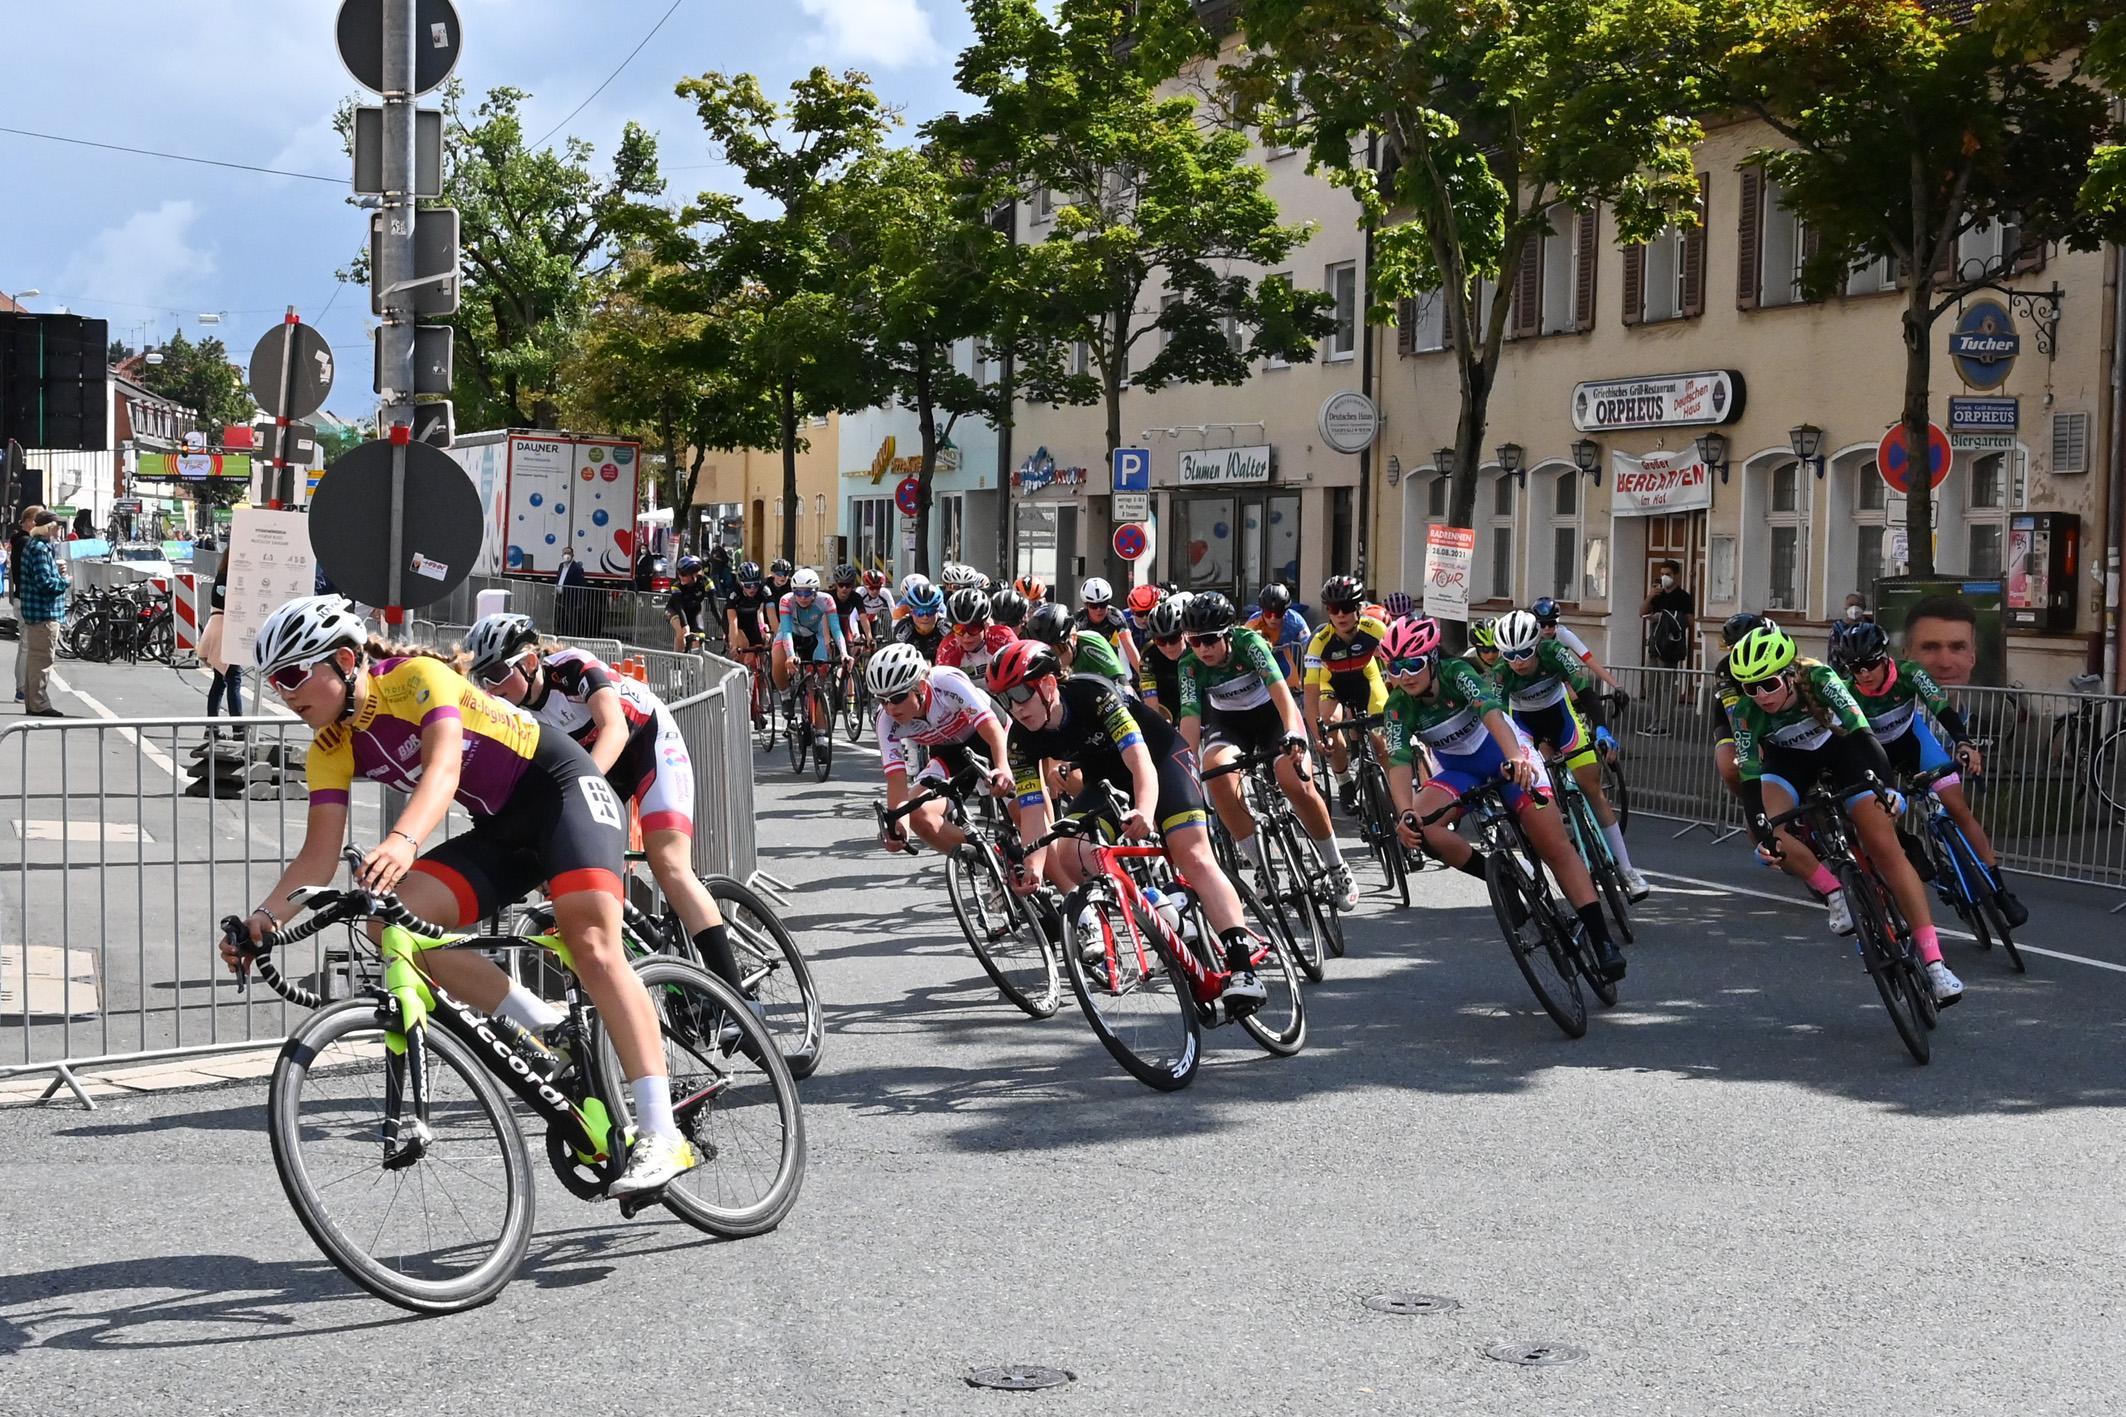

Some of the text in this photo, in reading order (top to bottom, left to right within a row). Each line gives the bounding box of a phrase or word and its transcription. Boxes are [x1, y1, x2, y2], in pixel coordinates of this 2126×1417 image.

[1959, 336, 2014, 351] Tucher
[1595, 395, 1664, 424] ORPHEUS
[1953, 410, 2015, 423] ORPHEUS
[517, 442, 559, 453] DAUNER
[1951, 434, 2012, 449] Biergarten
[1121, 454, 1142, 486] P
[1182, 451, 1267, 480] Blumen Walter
[1430, 529, 1472, 542] RADRENNEN
[1432, 547, 1466, 558] 28.08.2021
[1431, 568, 1464, 588] TOUR
